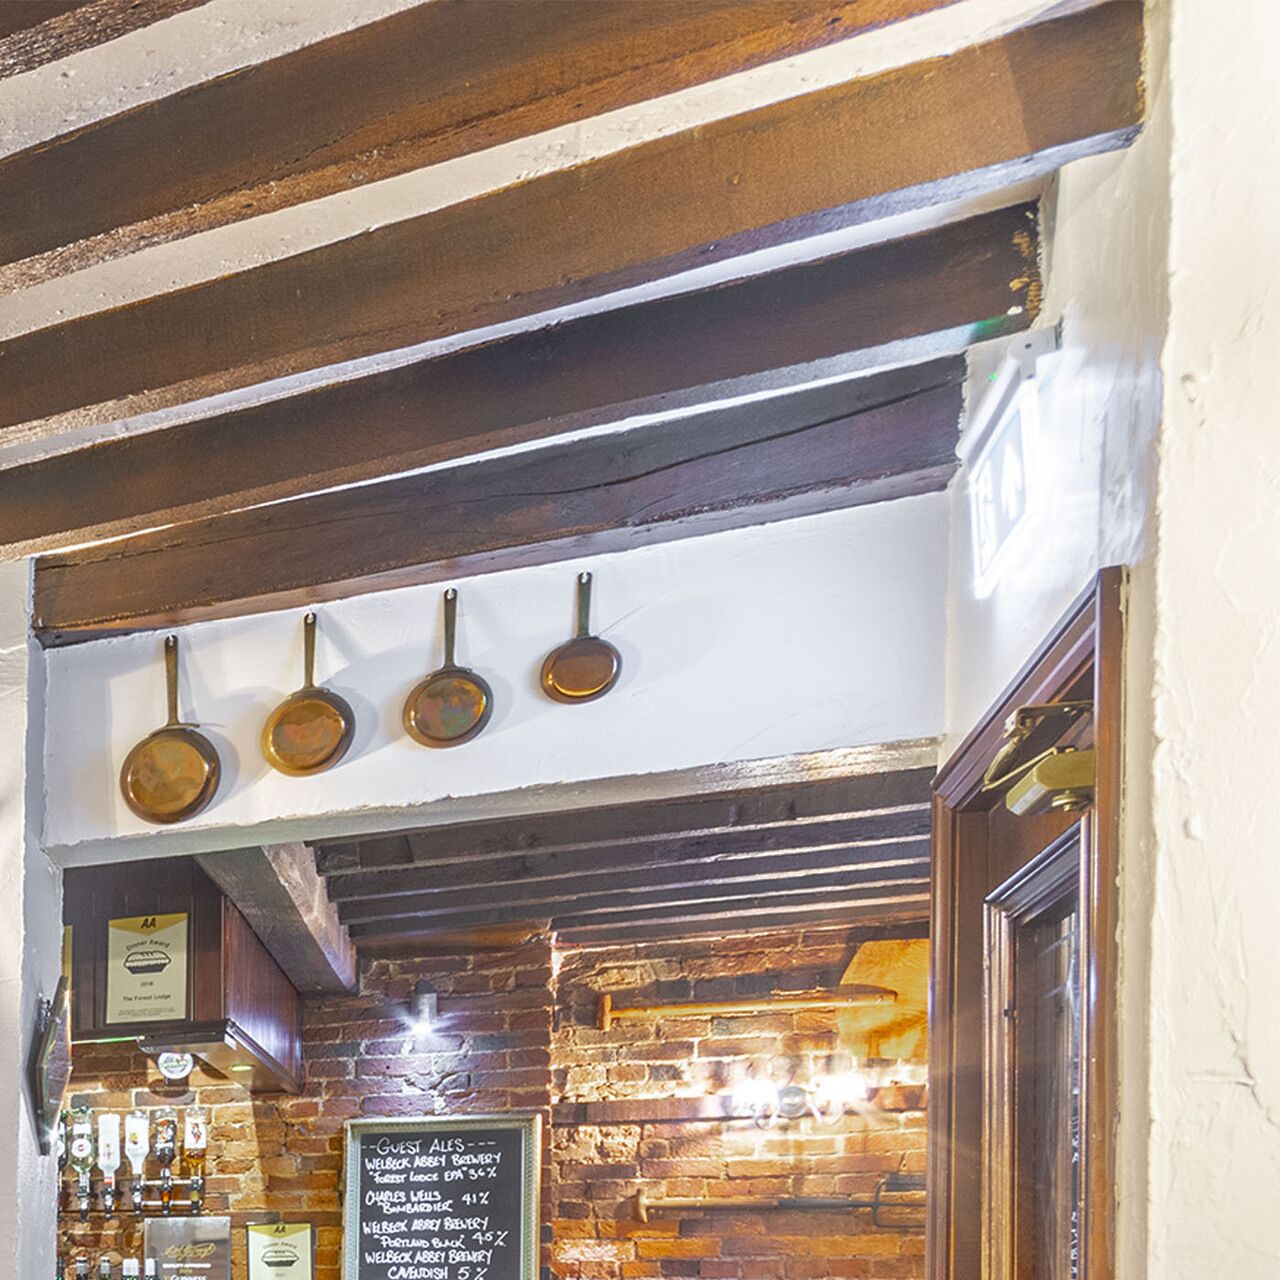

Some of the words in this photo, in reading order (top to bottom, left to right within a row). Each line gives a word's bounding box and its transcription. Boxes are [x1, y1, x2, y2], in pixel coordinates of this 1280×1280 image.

[141, 917, 156, 929] AA
[376, 1137, 423, 1155] GUEST
[429, 1138, 465, 1154] ALES
[365, 1156, 412, 1171] WELBECK
[413, 1154, 447, 1168] ABBEY
[451, 1152, 501, 1166] BREWERY
[410, 1189, 441, 1202] WELLS
[362, 1219, 408, 1235] WELBECK
[411, 1218, 441, 1232] ABBEY
[443, 1216, 489, 1232] BREWERY
[365, 1249, 412, 1264] WELBECK
[414, 1250, 446, 1264] ABBEY
[448, 1249, 493, 1264] BREWERY
[387, 1266, 448, 1280] CAVENDISH
